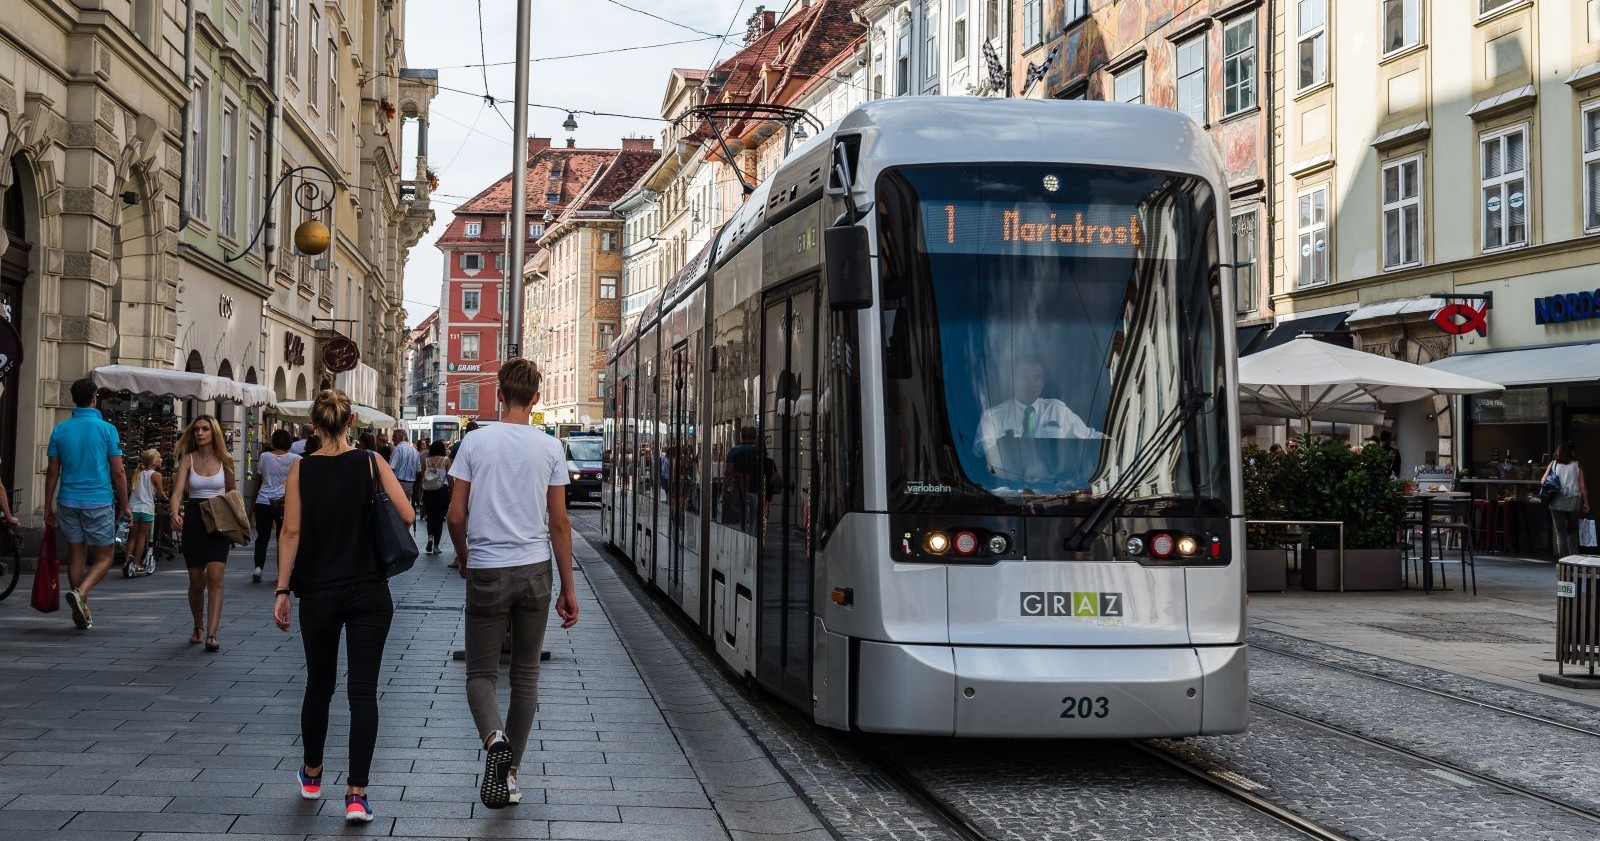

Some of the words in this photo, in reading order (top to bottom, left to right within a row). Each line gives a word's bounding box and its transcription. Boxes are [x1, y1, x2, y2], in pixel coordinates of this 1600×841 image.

[944, 205, 955, 243] 1
[1003, 210, 1140, 244] Mariatrost
[457, 364, 481, 372] GRAWE
[907, 484, 951, 493] variobahn
[1021, 592, 1122, 616] GRAZ
[1059, 696, 1110, 719] 203
